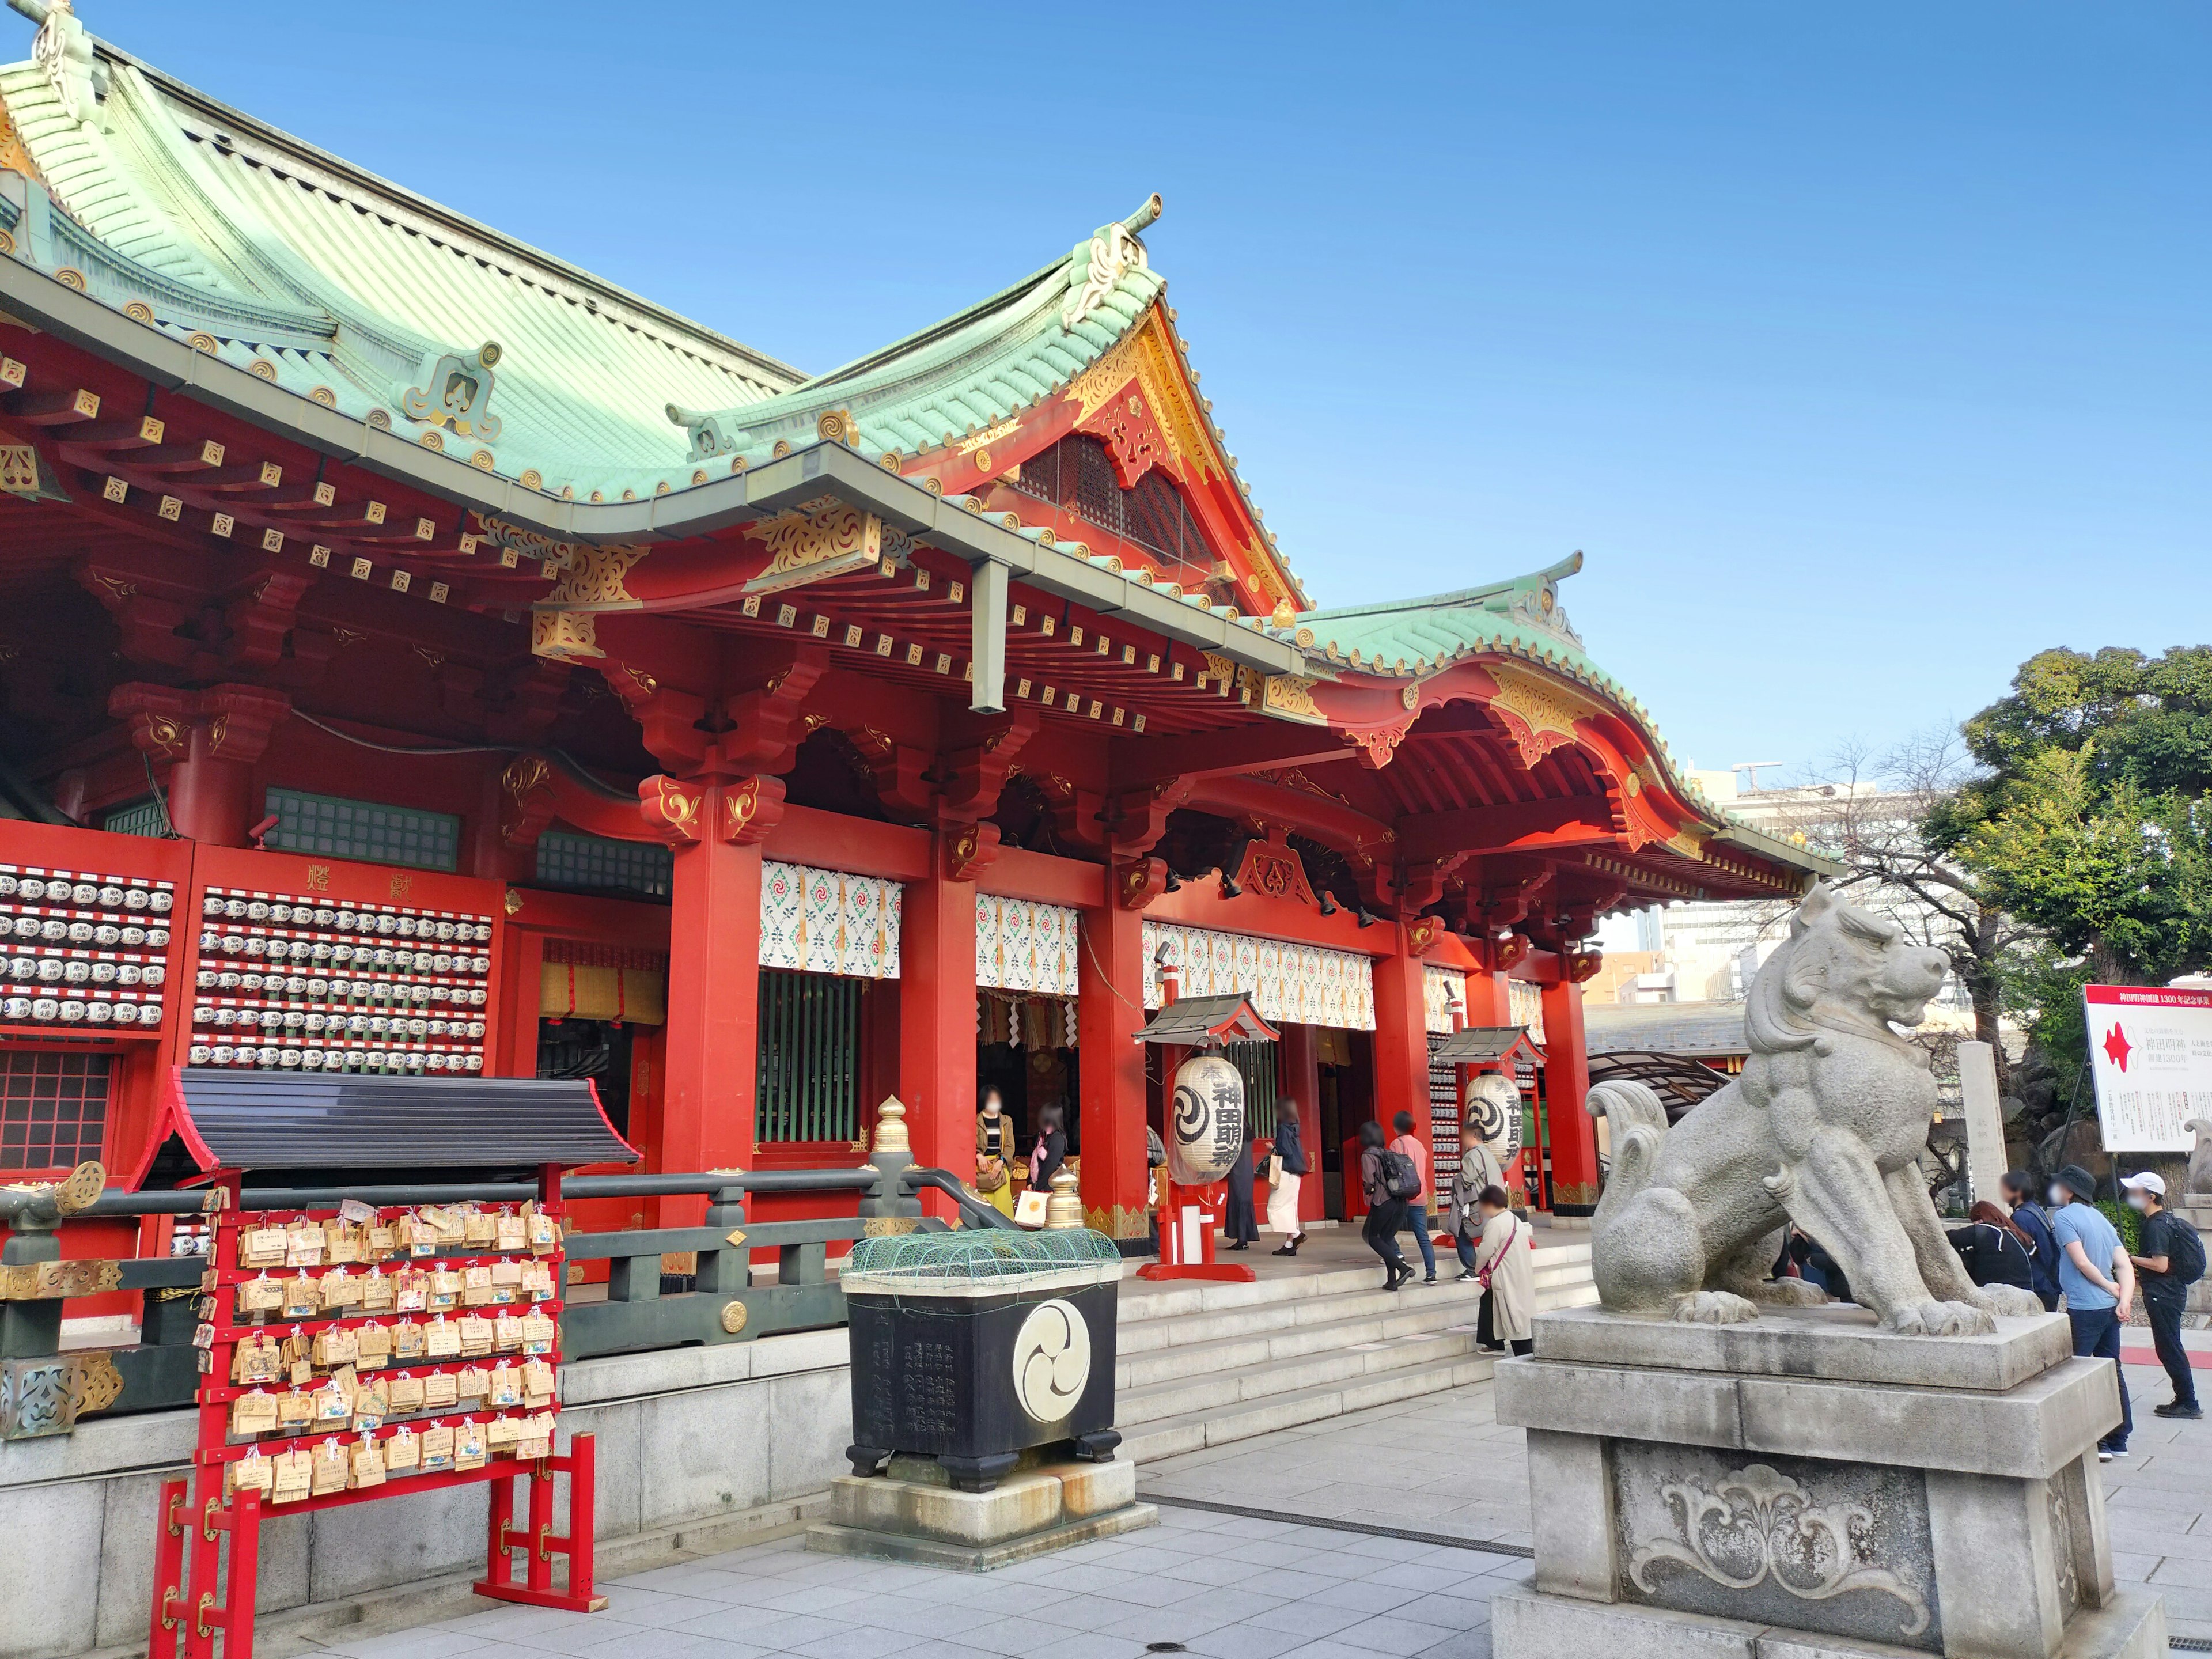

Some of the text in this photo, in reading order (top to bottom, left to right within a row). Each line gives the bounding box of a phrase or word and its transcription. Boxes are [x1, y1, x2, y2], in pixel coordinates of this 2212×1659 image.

[2146, 1037, 2186, 1051] 神田明神
[1208, 1082, 1243, 1168] 神田明神
